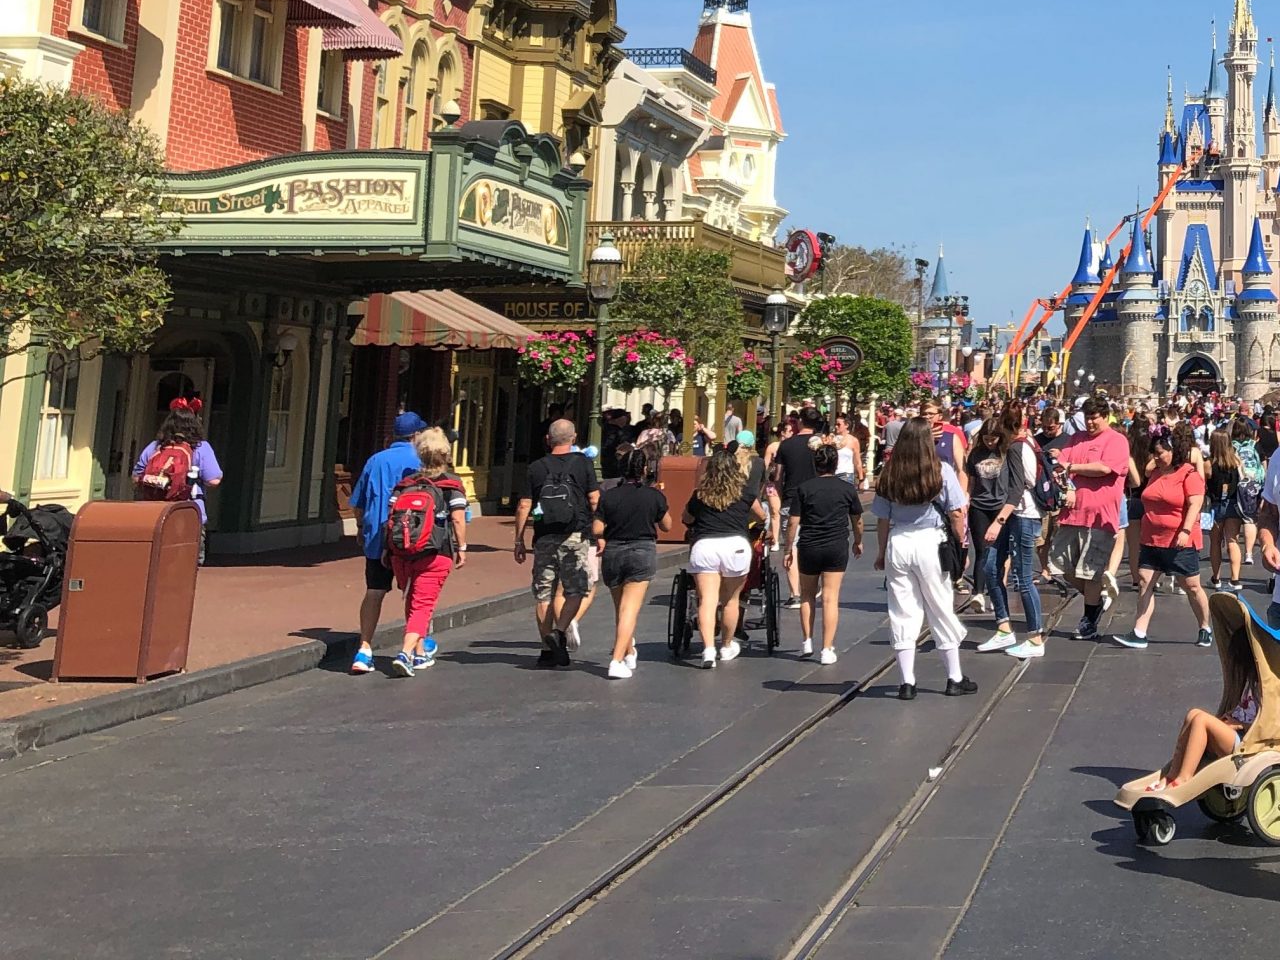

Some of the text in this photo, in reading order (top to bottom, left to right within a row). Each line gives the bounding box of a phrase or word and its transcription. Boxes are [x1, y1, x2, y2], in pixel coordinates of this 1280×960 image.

[217, 192, 268, 212] Street
[282, 178, 407, 215] FASHION
[338, 198, 410, 215] APPAREL
[504, 302, 560, 317] HOUSE
[563, 302, 585, 316] OF
